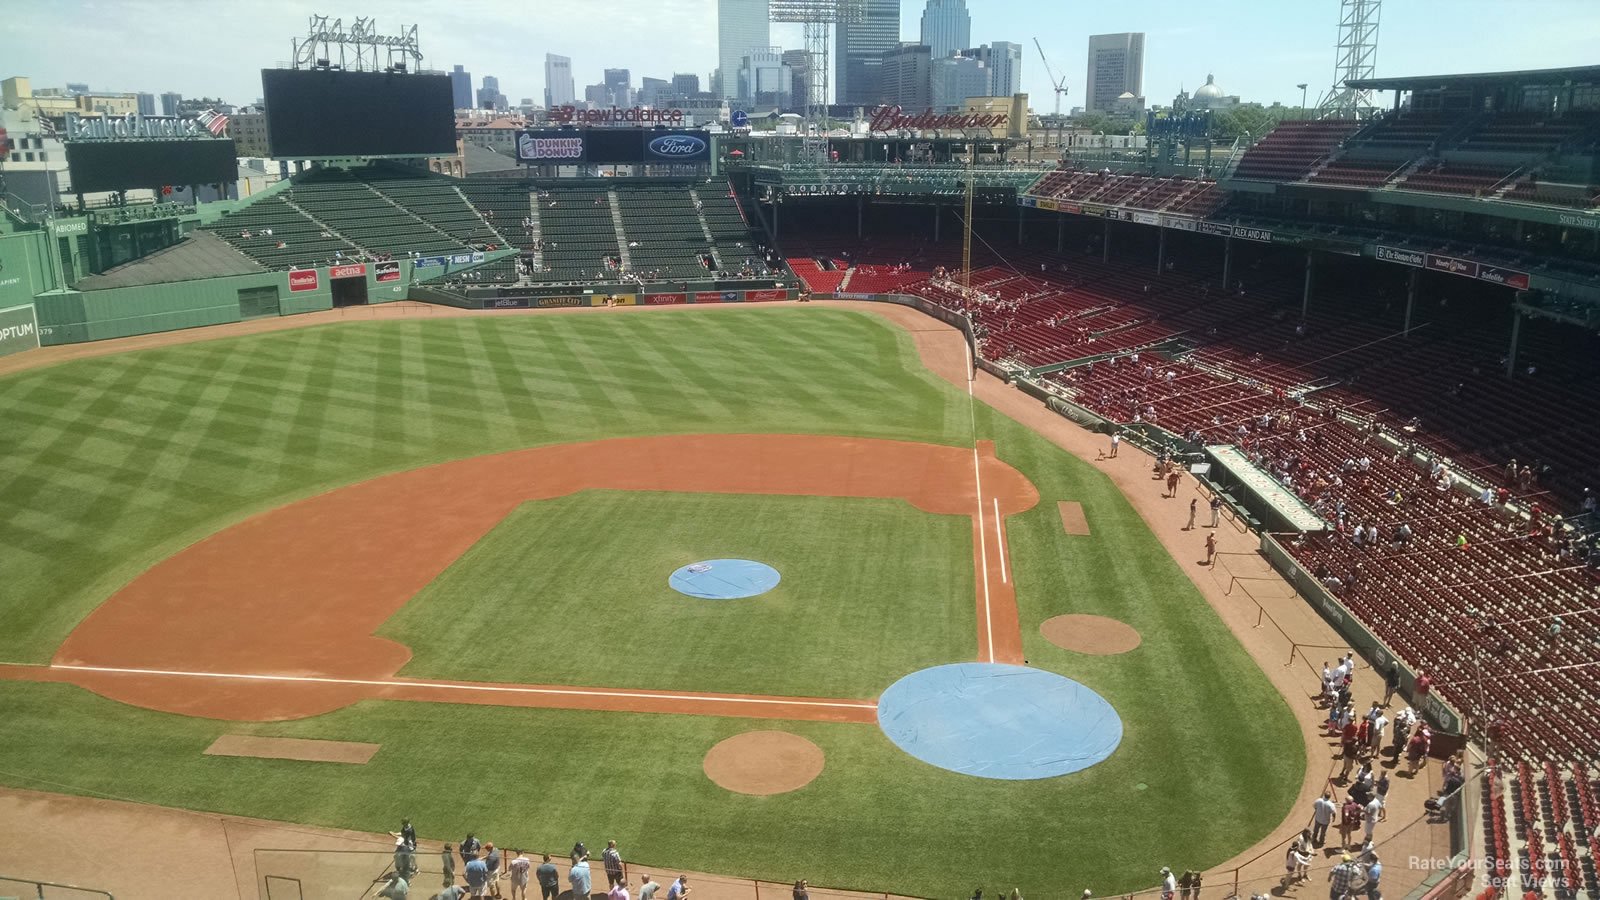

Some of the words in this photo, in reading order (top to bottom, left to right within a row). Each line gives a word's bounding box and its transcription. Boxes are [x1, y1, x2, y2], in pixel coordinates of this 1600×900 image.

[576, 110, 612, 122] new
[612, 105, 683, 122] balance
[870, 104, 1008, 131] Budweiser
[65, 112, 116, 140] Bank
[135, 113, 200, 138] America
[536, 138, 582, 148] DUNKIN'
[662, 138, 695, 154] Ford
[1560, 214, 1575, 225] STATE
[55, 222, 86, 234] ABIOMED
[1234, 227, 1247, 237] ALEX
[1247, 228, 1260, 239] AND
[335, 266, 361, 276] aetna
[1481, 271, 1504, 282] Safelite
[0, 277, 20, 286] APIENT
[495, 299, 518, 307] jetBlue
[653, 294, 677, 304] xfinity
